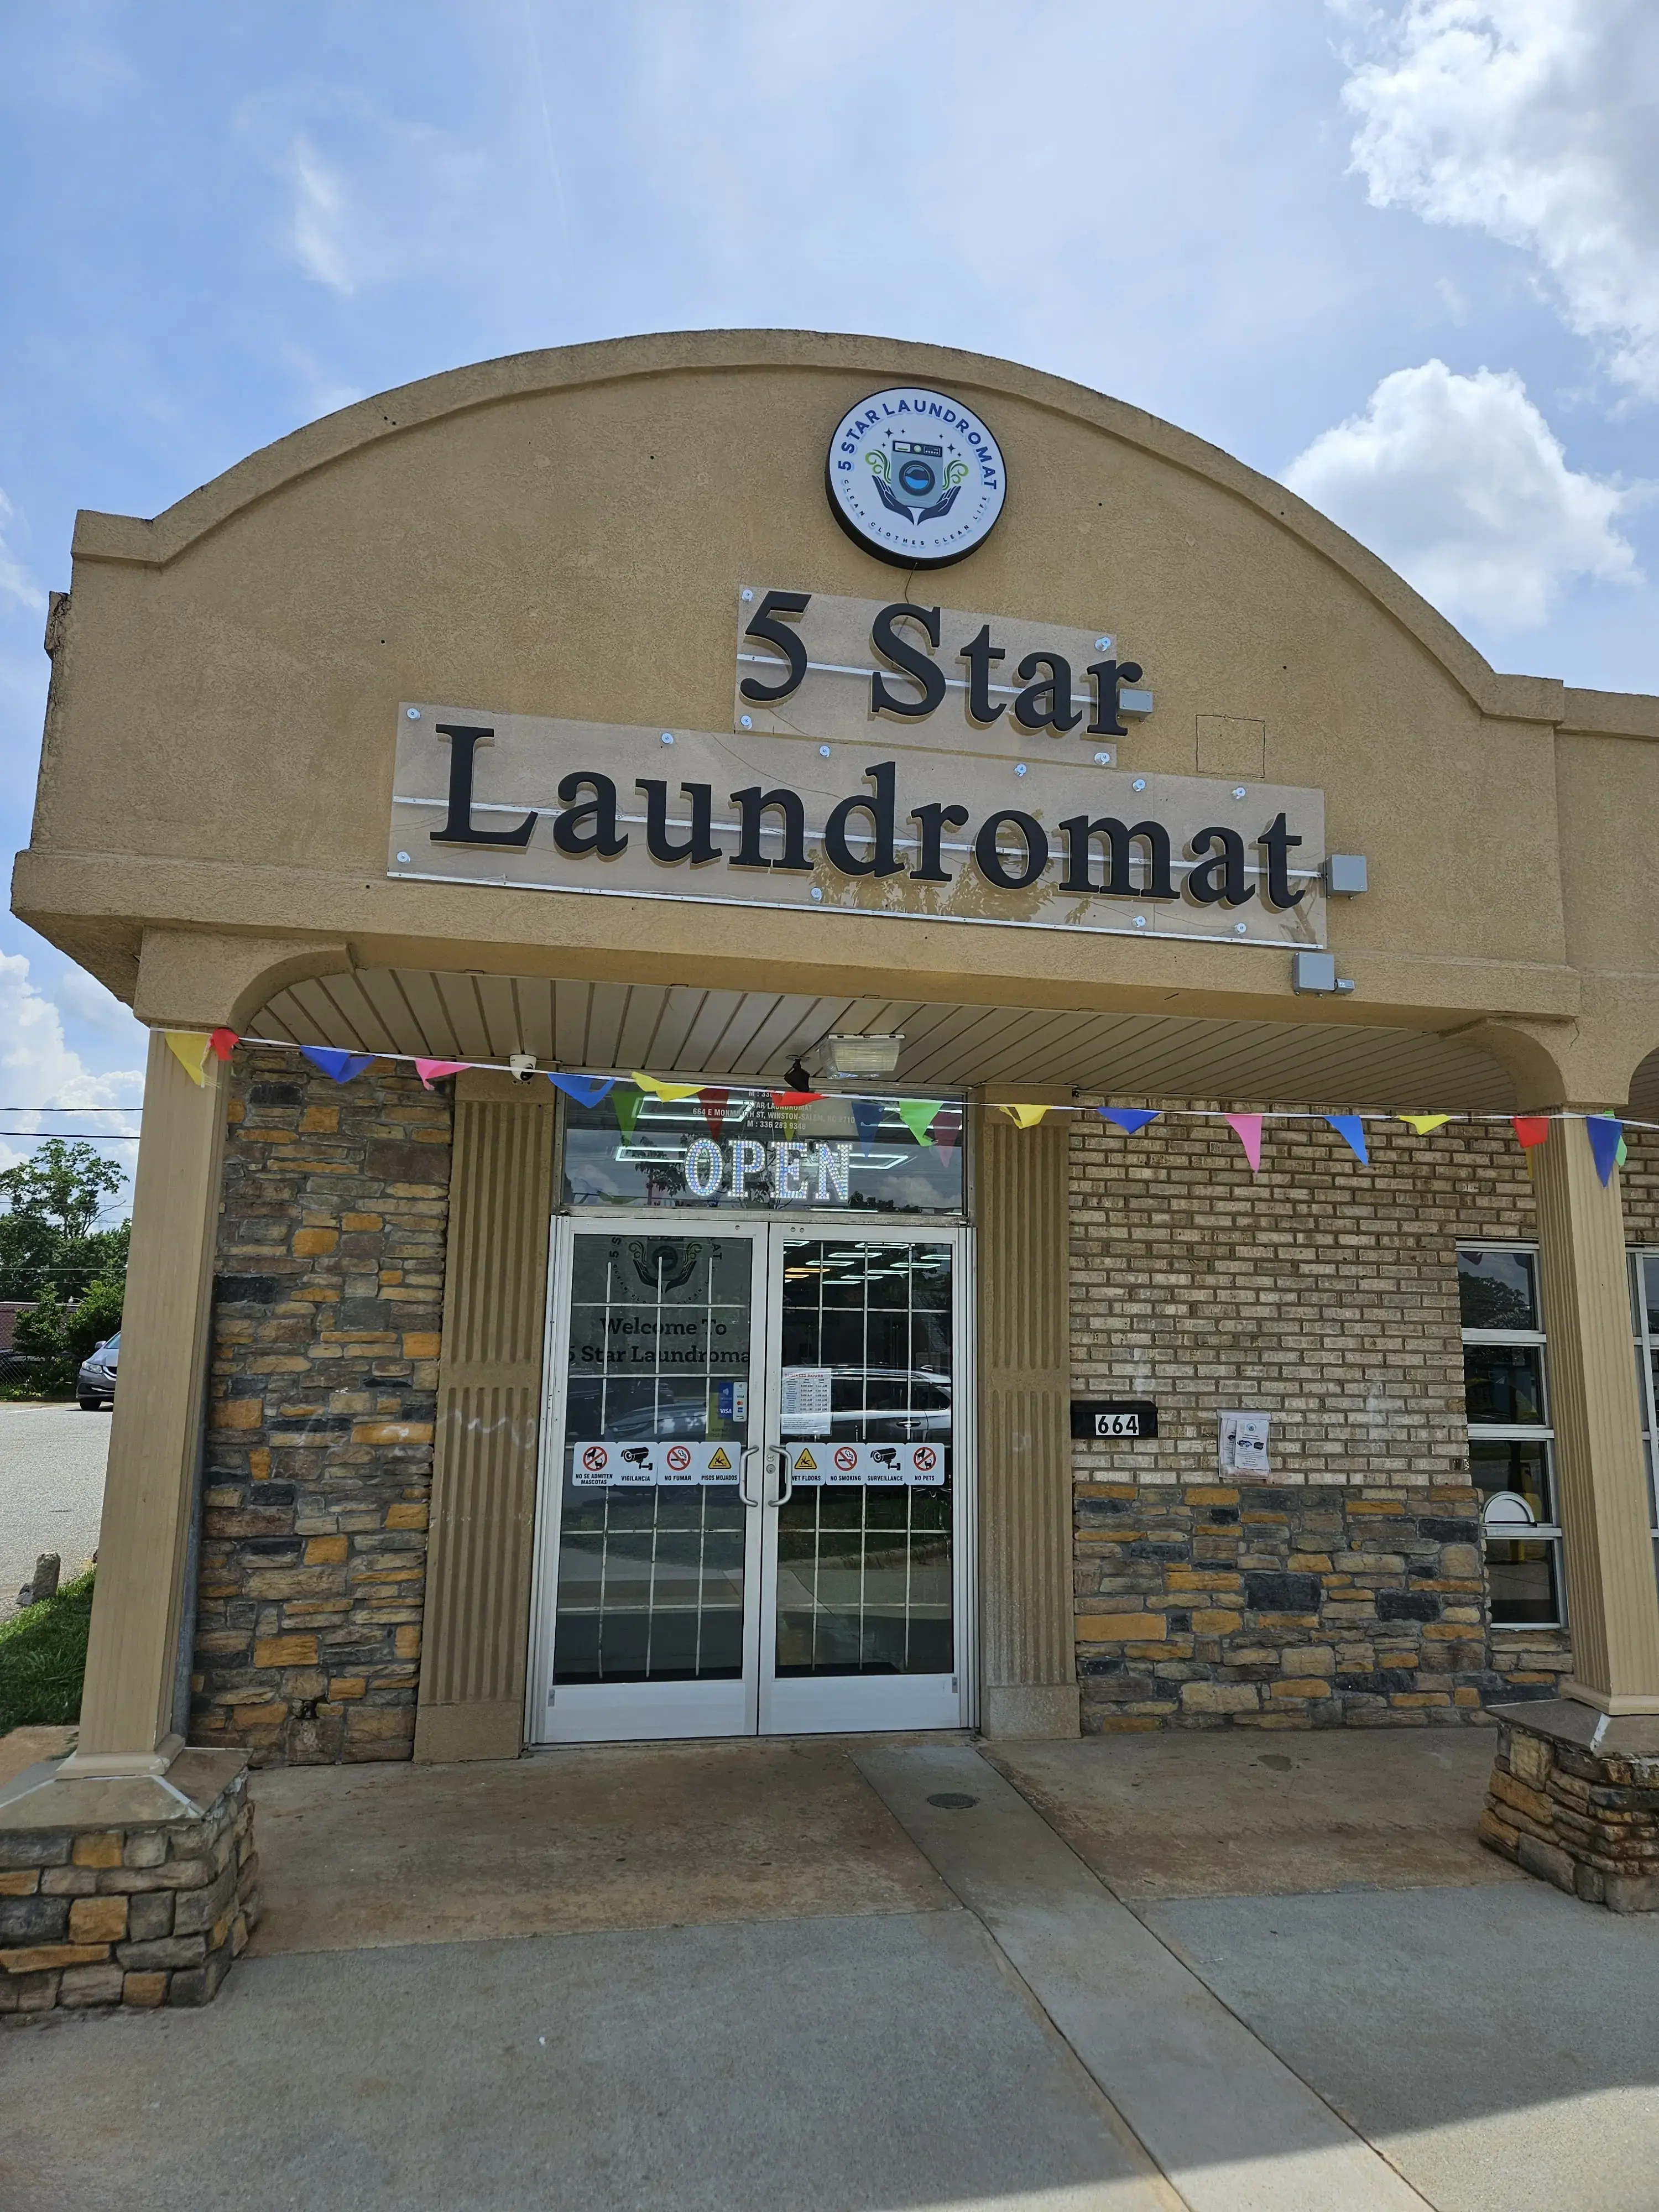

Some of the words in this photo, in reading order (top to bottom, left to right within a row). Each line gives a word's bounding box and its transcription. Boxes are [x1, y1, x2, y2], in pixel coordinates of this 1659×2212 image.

[841, 409, 881, 454] STAR
[882, 399, 997, 490] LAUNDROMAT
[838, 460, 852, 471] 5
[844, 479, 865, 517] CLEAN
[870, 521, 925, 546] CLOTHES
[935, 524, 969, 545] CLEAN
[973, 495, 988, 520] LIFE
[739, 590, 812, 702] 5
[870, 603, 1142, 737] Star
[430, 723, 1307, 910] Laundromat
[685, 1138, 853, 1201] OPEN
[599, 1317, 697, 1335] Welcome
[701, 1318, 727, 1335] To
[581, 1345, 627, 1362] Star
[631, 1345, 750, 1363] Laundroma
[1098, 1416, 1138, 1434] 664
